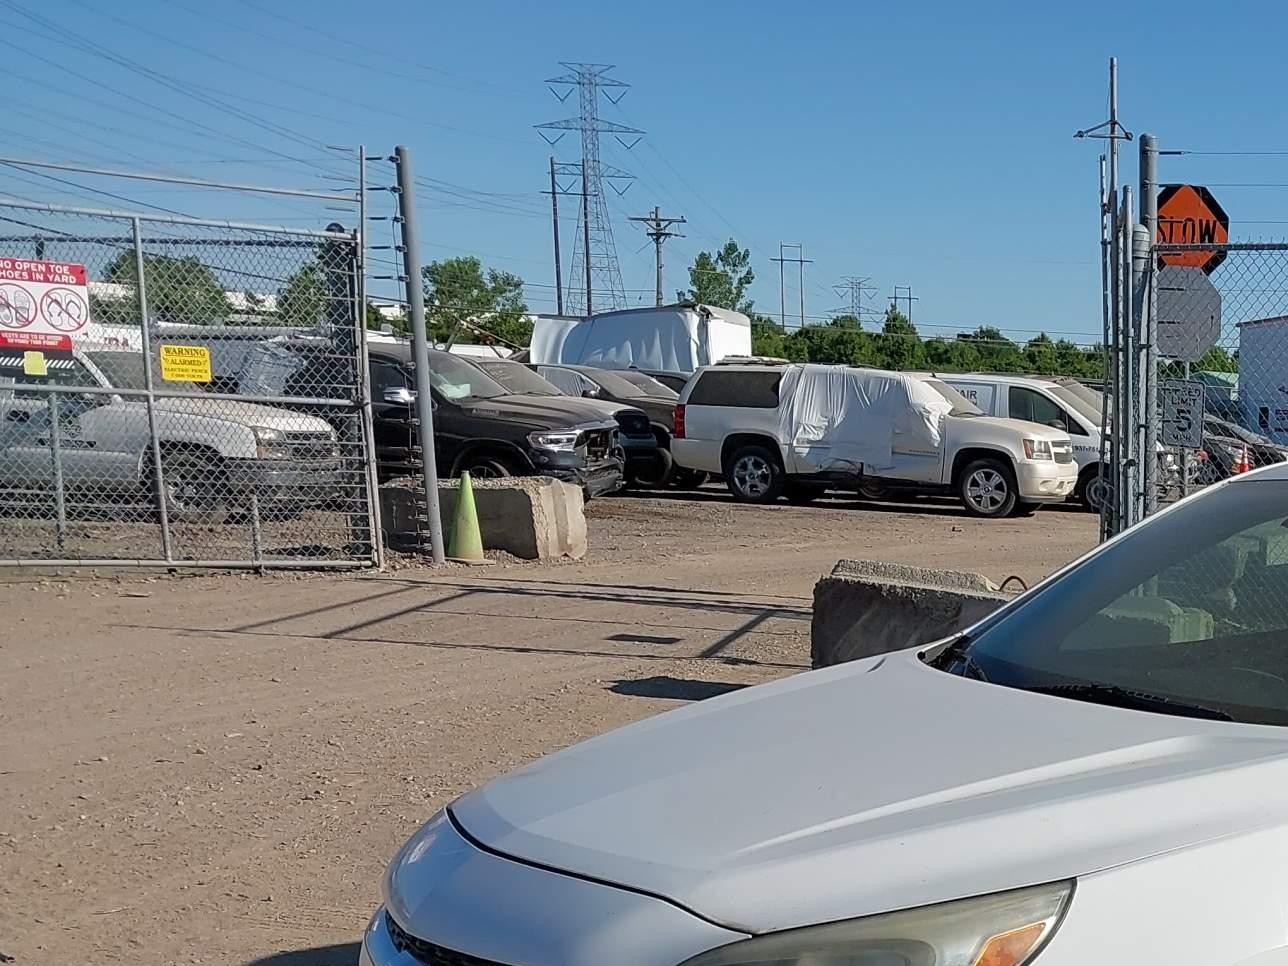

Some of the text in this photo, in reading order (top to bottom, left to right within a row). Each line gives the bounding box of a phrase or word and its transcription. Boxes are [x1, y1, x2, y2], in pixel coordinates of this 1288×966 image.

[15, 261, 46, 272] OPEN
[49, 264, 70, 274] TOE
[0, 269, 77, 284] HOES IN YARD
[163, 347, 206, 357] WARNING
[171, 358, 202, 366] ALARMED
[1171, 396, 1197, 407] LIMIT
[1175, 408, 1192, 432] 5
